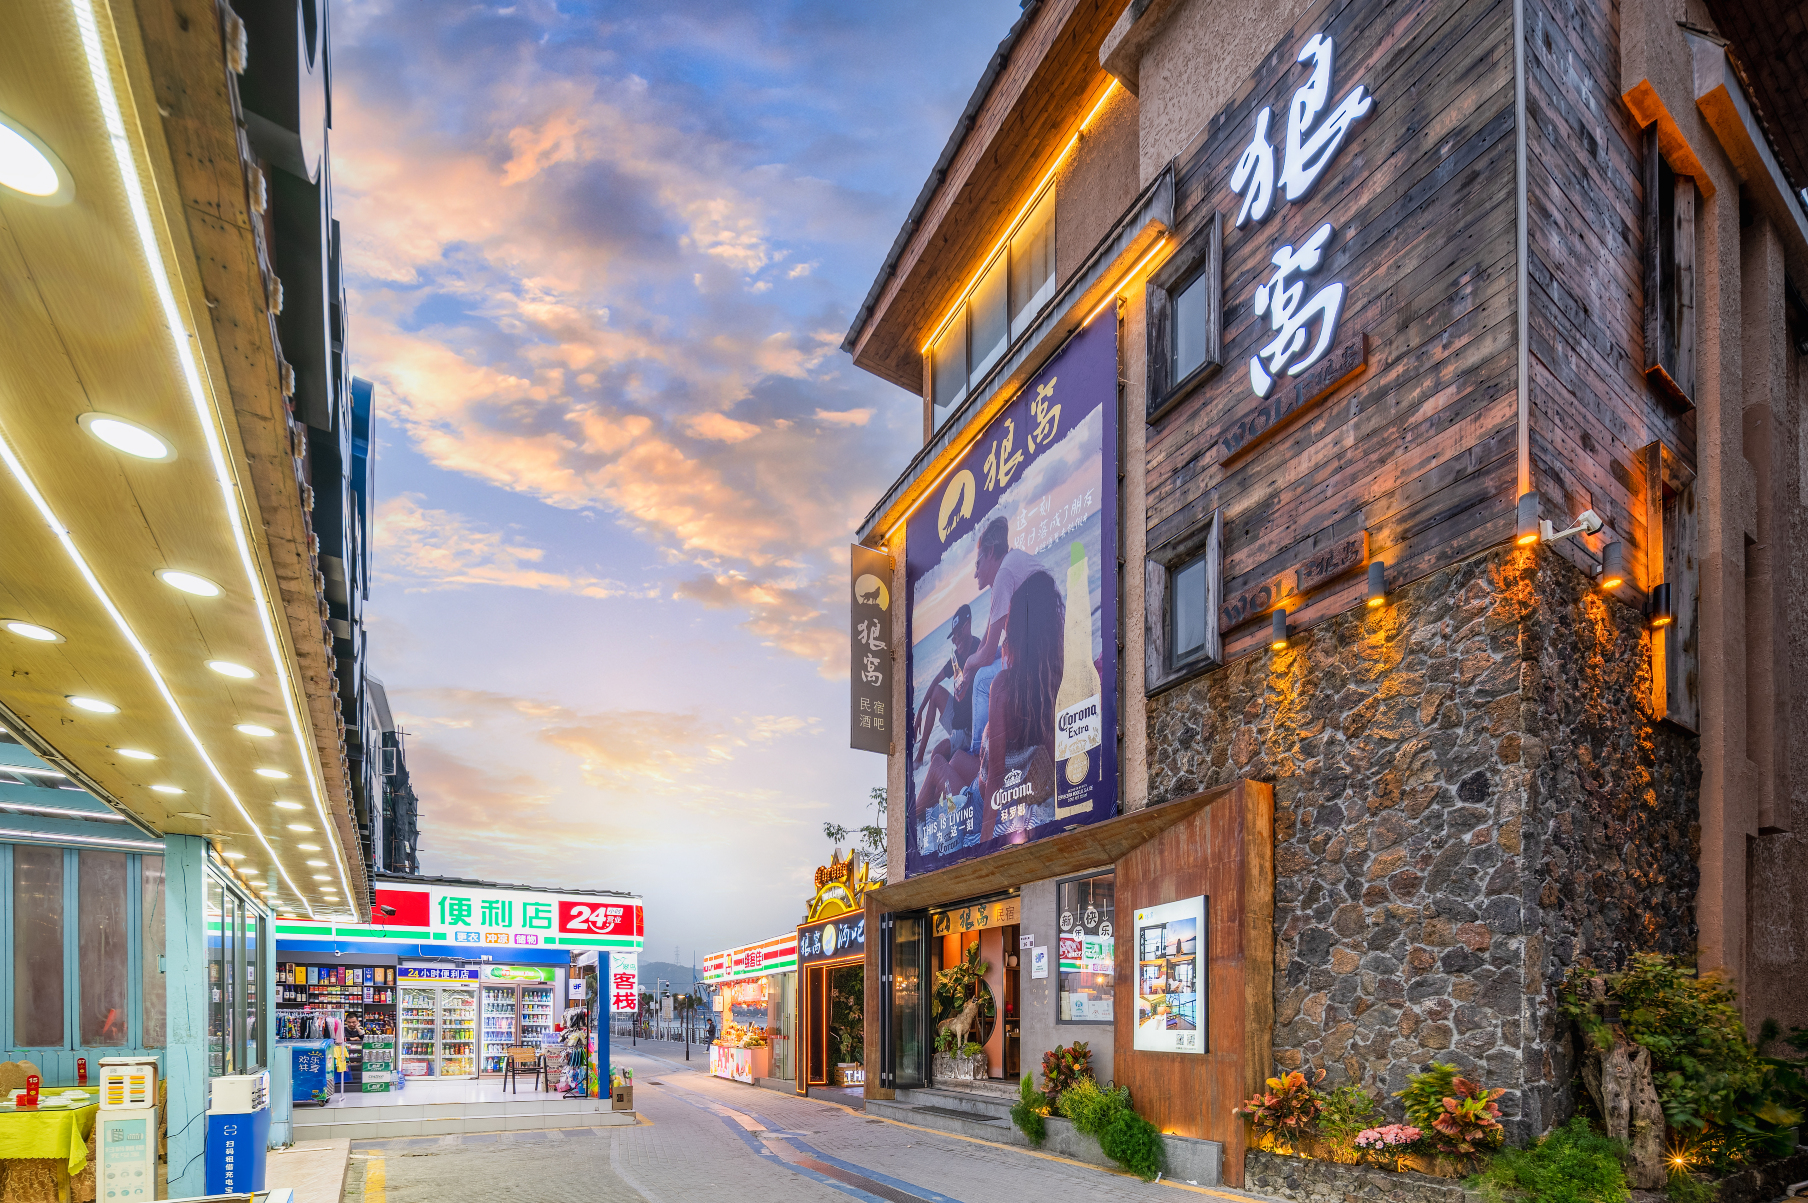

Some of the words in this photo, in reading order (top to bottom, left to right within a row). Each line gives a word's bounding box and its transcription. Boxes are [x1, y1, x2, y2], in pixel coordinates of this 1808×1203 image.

[1229, 33, 1371, 397] 狼窝
[1222, 373, 1314, 454] WOLF
[984, 376, 1062, 492] 狼窝
[1016, 495, 1051, 530] 这一刻
[1222, 560, 1316, 625] WOLF
[857, 619, 887, 687] 狼窝
[860, 697, 885, 715] 民宿
[1058, 704, 1097, 732] Corona
[860, 714, 885, 731] 酒吧
[1068, 724, 1089, 739] Extra
[991, 782, 1034, 810] Corona
[923, 822, 938, 837] THIS
[940, 818, 947, 830] IS
[949, 806, 974, 826] LIVING
[438, 896, 552, 929] 便利店
[566, 906, 607, 930] 24
[960, 905, 988, 931] 狼窝
[996, 906, 1015, 922] 民宿
[457, 932, 478, 942] 更衣
[486, 934, 508, 943] 冲凉
[516, 935, 537, 944] 储物
[408, 969, 469, 978] 24小时便利店
[612, 972, 636, 1010] 客栈
[299, 1055, 320, 1064] 欢乐
